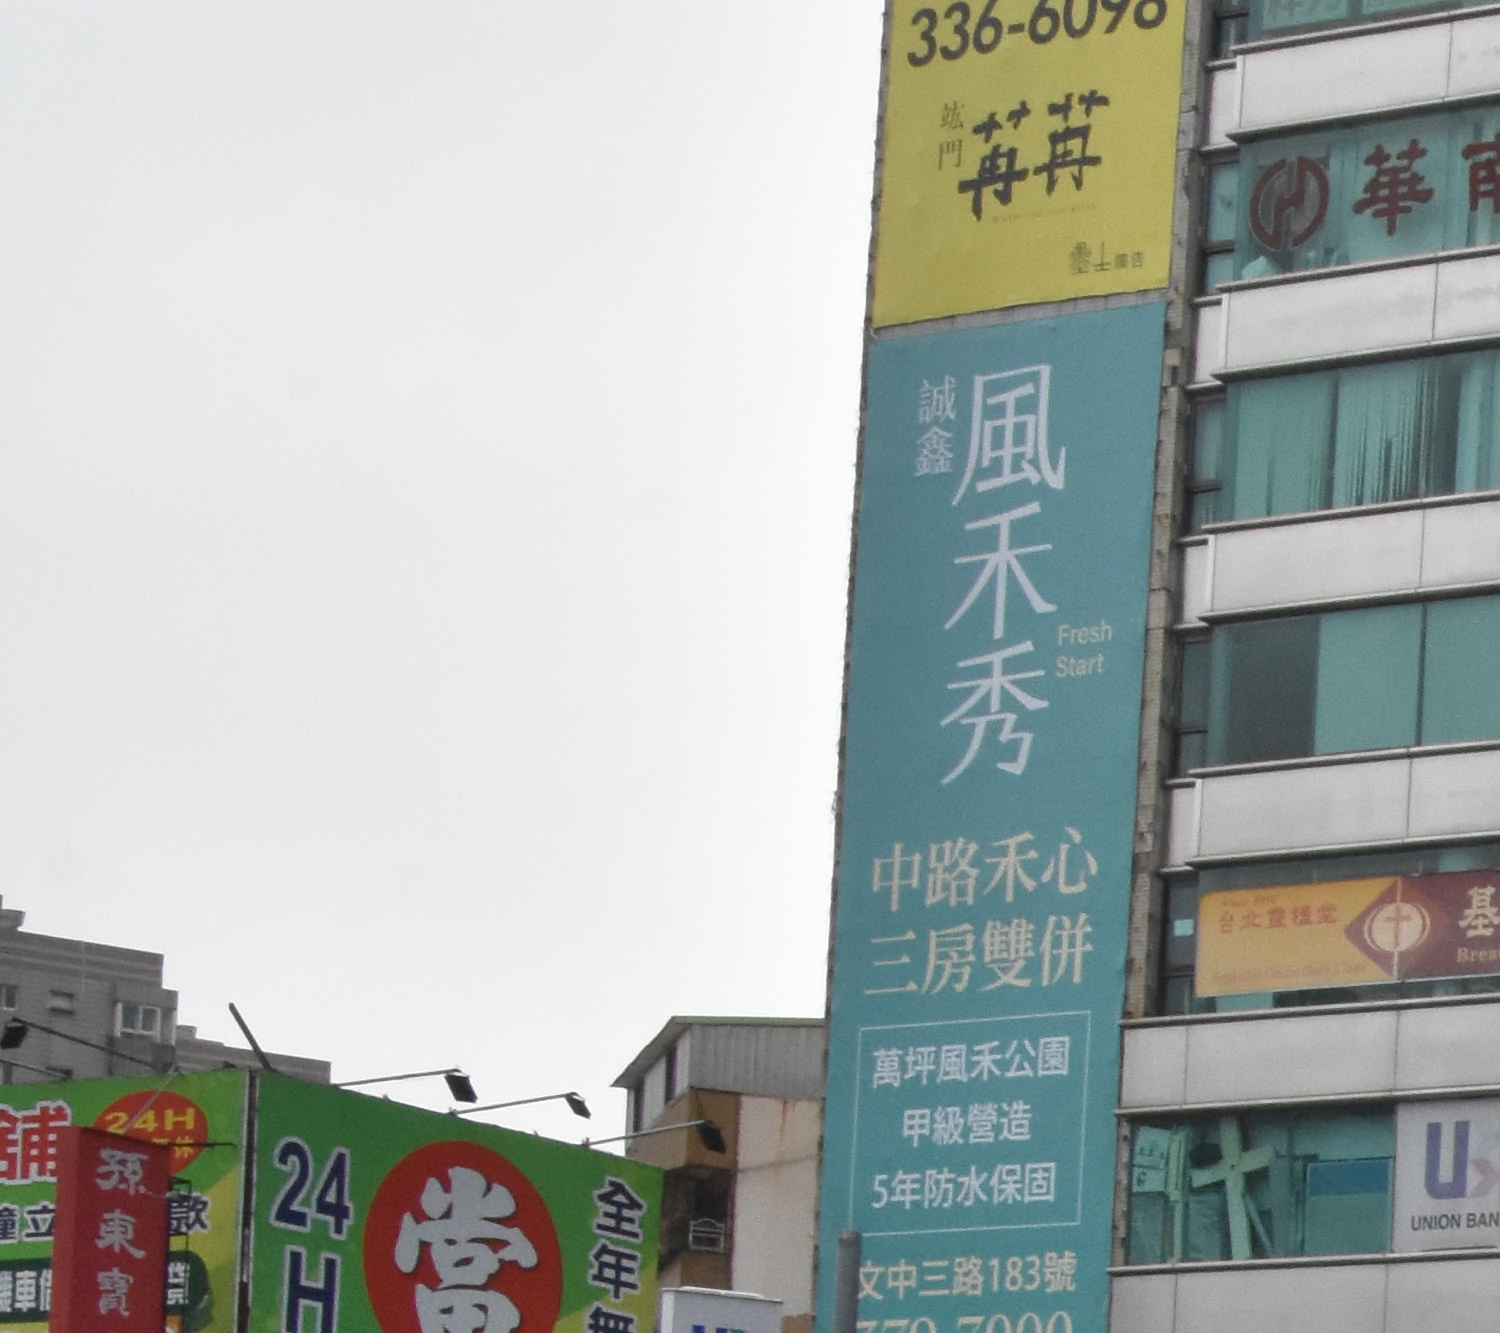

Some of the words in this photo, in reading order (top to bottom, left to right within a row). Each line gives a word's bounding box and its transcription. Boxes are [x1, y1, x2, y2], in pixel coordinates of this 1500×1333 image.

[914, 375, 957, 477] 誠鑫
[940, 363, 1067, 786] 風禾秀
[1057, 621, 1113, 646] Fresh
[1055, 654, 1105, 679] Start
[871, 826, 1100, 914] 中路禾心
[864, 913, 1093, 1000] 三房雙併
[871, 1035, 1071, 1090] 萬坪風禾公園
[901, 1100, 1033, 1146] 甲級營造
[271, 1135, 354, 1243] 24
[872, 1162, 1056, 1211] 5年防水保固
[1410, 1212, 1462, 1233] UNION
